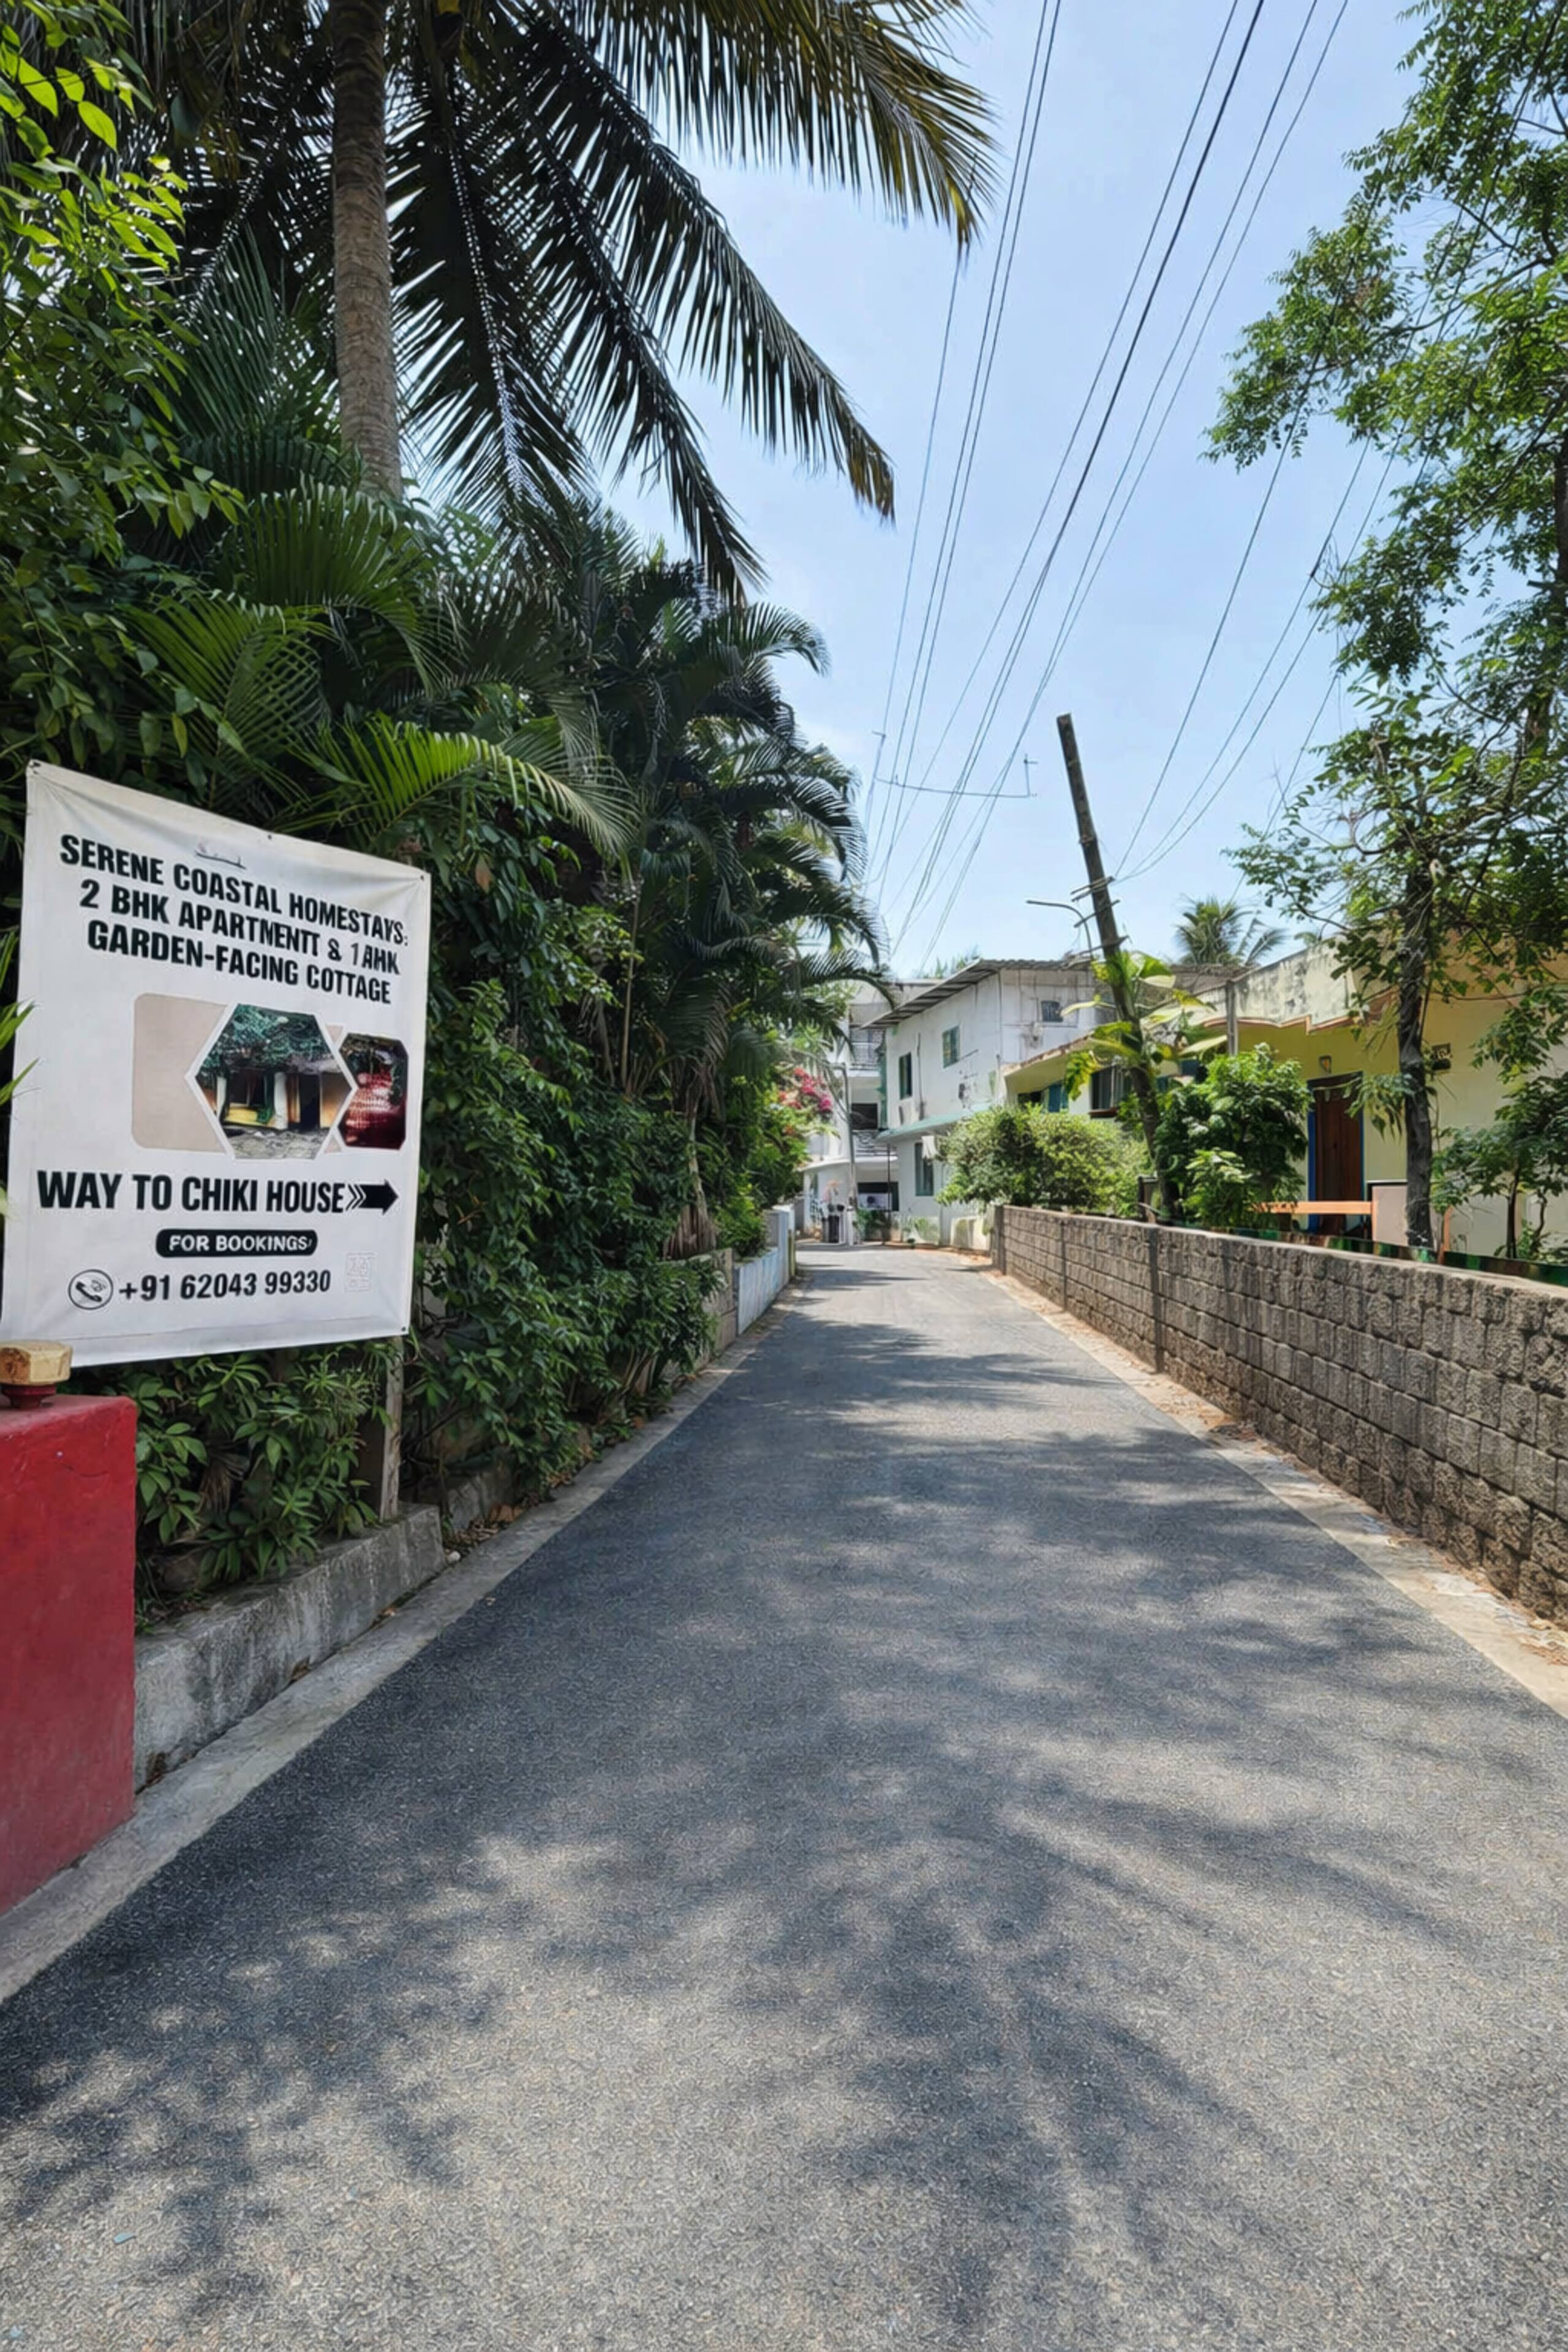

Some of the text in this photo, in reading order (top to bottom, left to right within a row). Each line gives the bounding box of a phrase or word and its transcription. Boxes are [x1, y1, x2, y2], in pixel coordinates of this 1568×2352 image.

[60, 834, 164, 886] SERENE
[173, 864, 282, 914] COASTAL
[80, 879, 100, 909] 2
[111, 884, 169, 924] BHK
[328, 938, 342, 962] &
[88, 920, 391, 1004] GARDEN-FACING COTTAGE
[37, 1170, 345, 1213] WAY TO CHIKI HOUSE
[169, 1235, 209, 1251] FOR
[119, 1270, 331, 1301] +91 62043 99330
